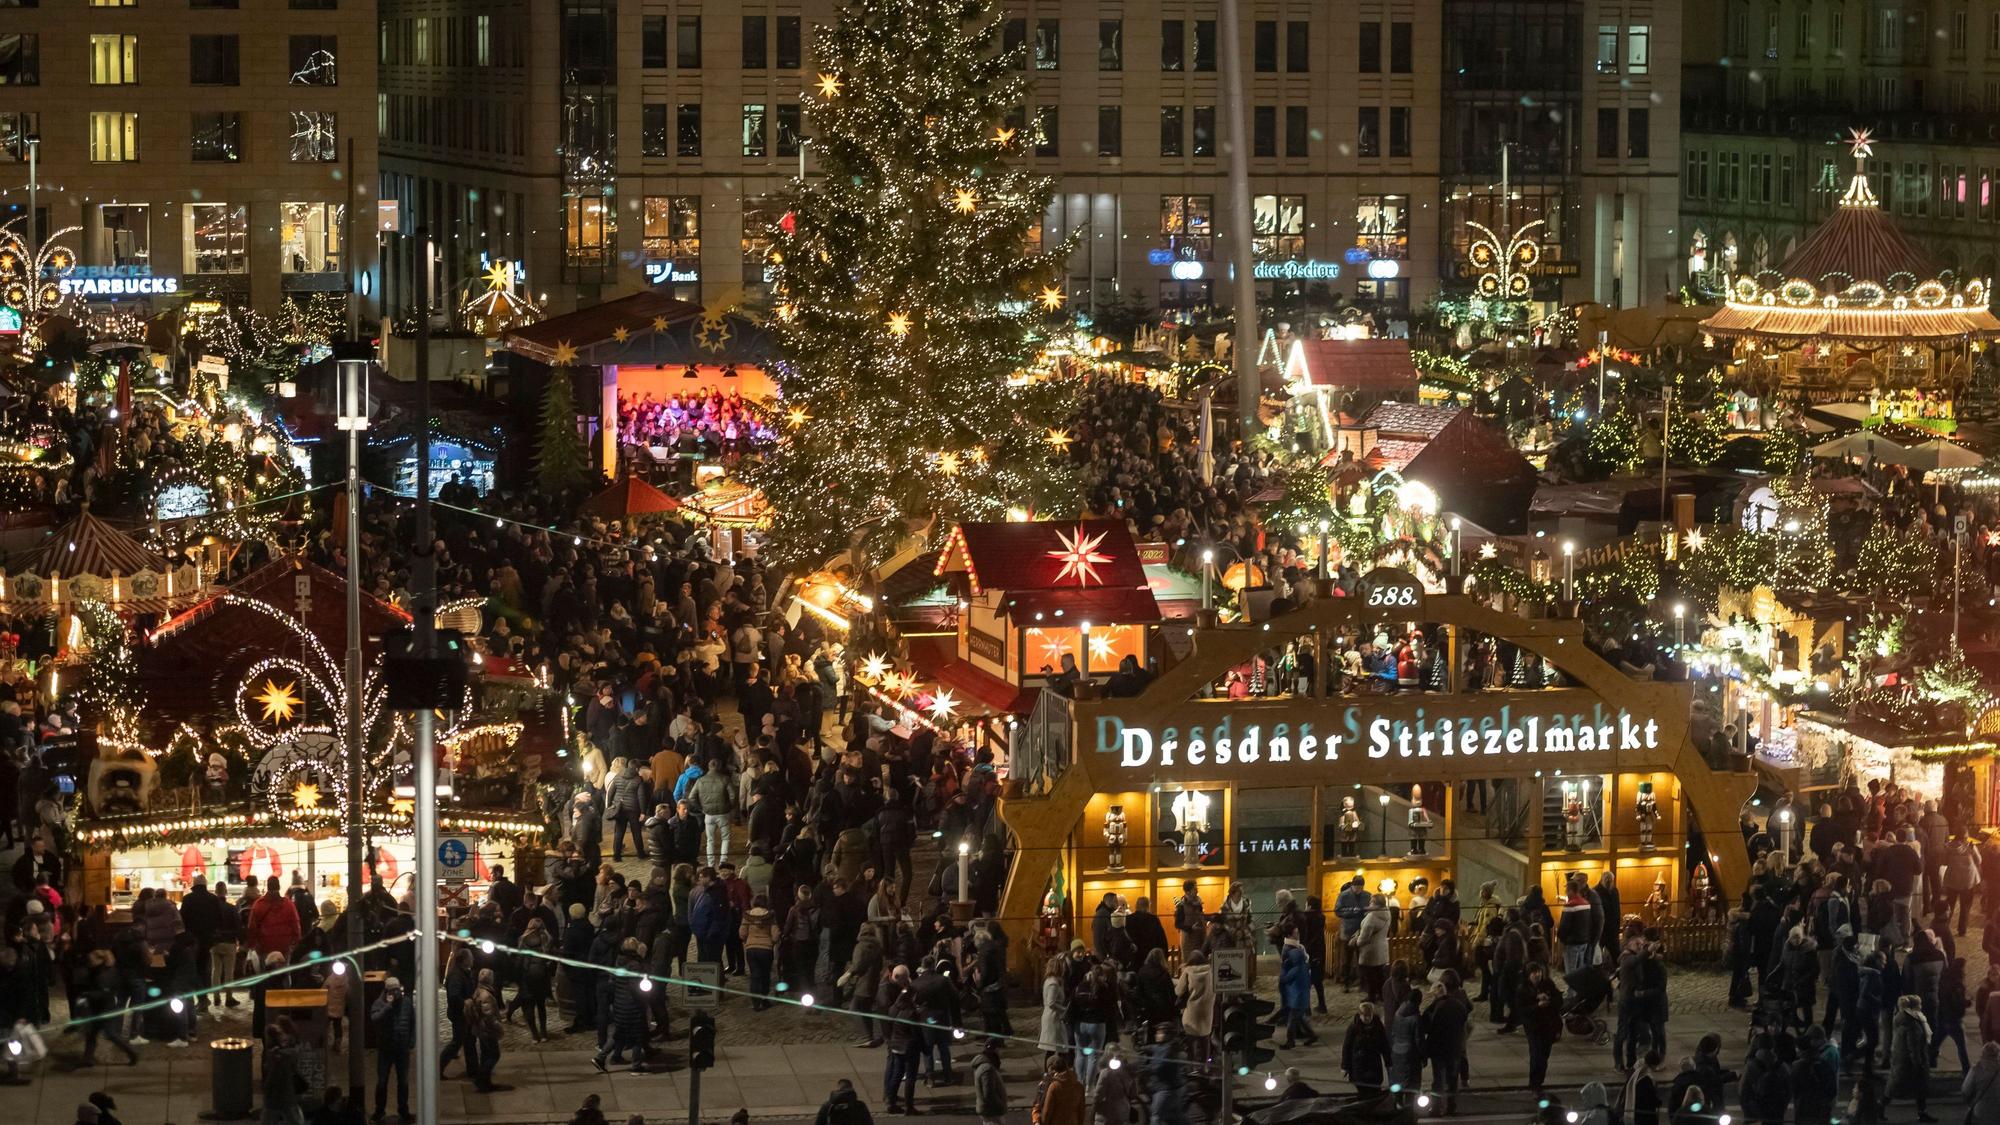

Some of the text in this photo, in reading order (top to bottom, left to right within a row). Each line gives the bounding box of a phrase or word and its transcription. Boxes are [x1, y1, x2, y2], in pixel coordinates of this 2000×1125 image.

[646, 264, 698, 281] BB Bank
[1229, 260, 1339, 279] cker-Pschorr
[59, 278, 178, 295] STARBUCKS
[1368, 586, 1418, 606] 588.
[1120, 713, 1659, 768] Dresdner Striezelmarkt
[1239, 838, 1312, 853] LTMARK
[442, 869, 464, 877] ZONE
